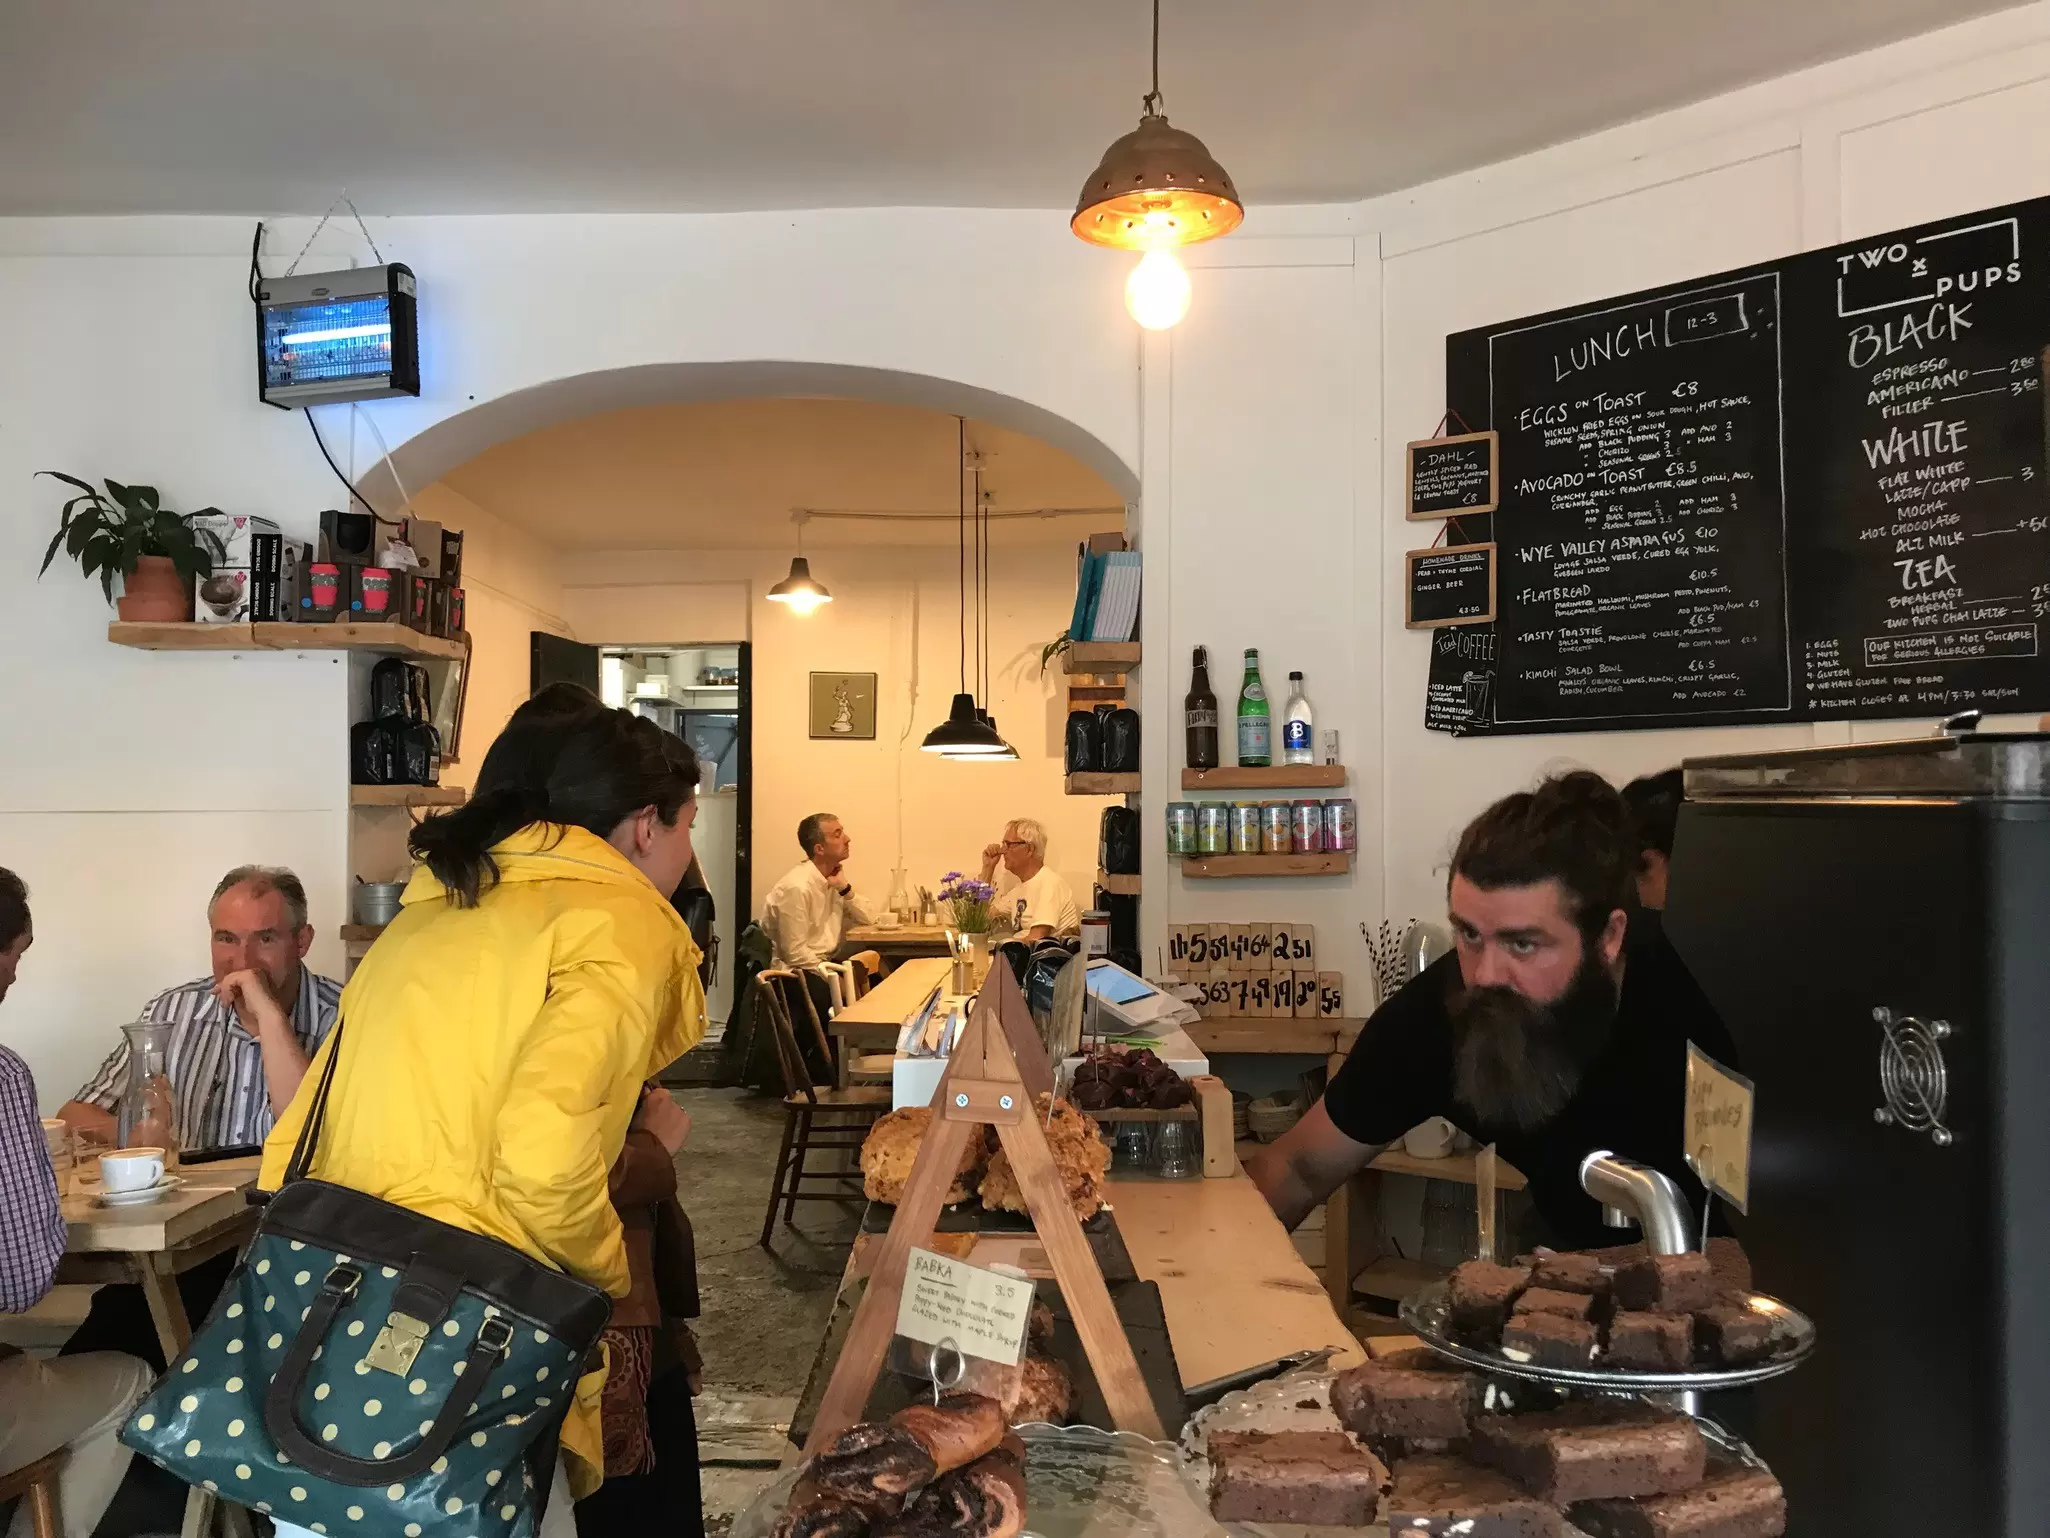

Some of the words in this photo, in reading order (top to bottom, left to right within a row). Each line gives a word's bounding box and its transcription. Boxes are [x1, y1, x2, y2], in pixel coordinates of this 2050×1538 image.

[1837, 243, 1908, 275] TWO
[1936, 263, 2022, 298] PUPS
[1848, 302, 1973, 369] BLACK
[1555, 318, 1657, 383] LUNCH
[1687, 312, 1718, 330] 12-3
[1871, 357, 1949, 385] ESPRESSO
[1672, 382, 1698, 397] €8
[1867, 369, 1969, 406] AMERICANO
[1519, 403, 1568, 431] EGGS
[1593, 391, 1647, 413] TOAST
[1882, 396, 1934, 419] FILTER
[1608, 415, 1629, 427] EGGS
[1598, 438, 1623, 448] BLACK
[1861, 420, 1968, 470] WHITE
[1428, 451, 1464, 466] DAHL
[1520, 472, 1584, 497] AVOCADO
[1599, 467, 1645, 485] TOAST
[1878, 471, 1910, 491] FLAT
[1915, 460, 1965, 481] WHITE
[2021, 464, 2035, 482] 3
[1897, 499, 1948, 521] MOCHA
[1859, 526, 1887, 541] HOT
[1891, 513, 1960, 537] CHOCOLATE
[1521, 544, 1555, 563] WYE
[1561, 539, 1606, 557] VALLEY
[1694, 526, 1719, 539] €10
[1896, 537, 1925, 554] ALT
[1929, 531, 1965, 549] MILK
[1583, 556, 1607, 566] SALSA
[1643, 549, 1670, 560] CURED
[1674, 546, 1690, 557] EGG
[1893, 554, 1958, 591] TEA
[1417, 583, 1442, 592] GINGER
[1522, 584, 1591, 606] FLATBREAD
[1887, 587, 1965, 609] BREAKFAST
[1883, 617, 1909, 629] TWO
[1912, 614, 1939, 627] PUPS
[1942, 609, 1970, 624] CHAI
[1972, 606, 2010, 622] LATTE
[1910, 600, 1958, 615] HERBAL
[1457, 631, 1496, 660] COFFEE
[1522, 630, 1555, 643] TASTY
[1558, 625, 1603, 639] TOASTIE
[1814, 639, 1839, 649] EGGS
[1869, 641, 1890, 653] OUR
[1893, 635, 1937, 650] KITCHEN
[1944, 635, 1955, 644] IS
[1959, 634, 1980, 643] NOT
[1985, 630, 2032, 642] SUITABLE
[1816, 650, 1840, 659] NUTS
[1817, 660, 1840, 669] MILK
[1871, 653, 1888, 662] FOR
[1934, 645, 1986, 657] ALLERGIES
[1565, 666, 1593, 676] SALAD
[1599, 664, 1623, 674] BOWL
[1816, 668, 1851, 680] GLUTEN
[1446, 684, 1463, 693] LATTE
[1442, 705, 1474, 716] AMERICANO
[1189, 932, 1209, 963] 5
[1209, 934, 1229, 962] 59
[1250, 933, 1271, 957] 64
[1272, 932, 1291, 960] 2
[1292, 939, 1311, 959] 51
[1209, 980, 1230, 1004] 63
[1231, 979, 1249, 1011] 7
[1251, 978, 1270, 1008] 49
[1273, 979, 1291, 1009] 19
[1320, 987, 1341, 1015] 55
[914, 1256, 953, 1280] BABKA
